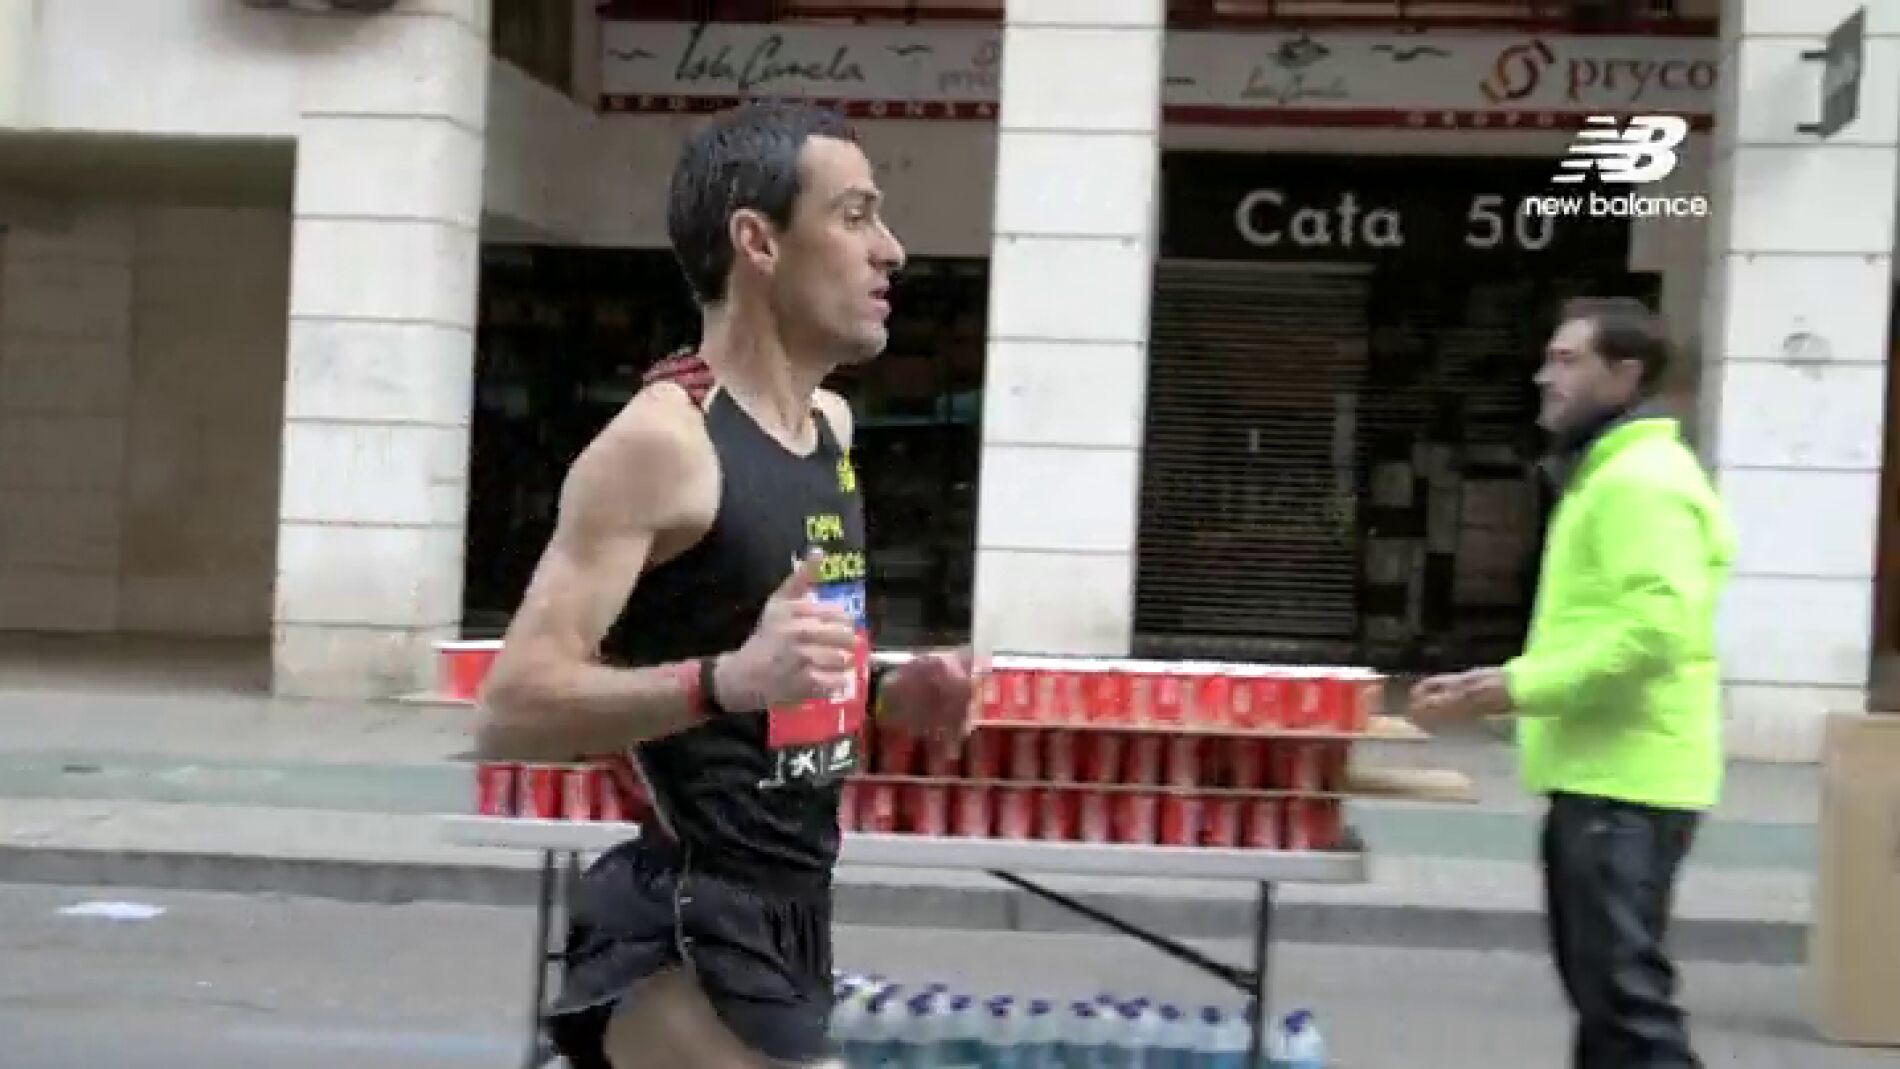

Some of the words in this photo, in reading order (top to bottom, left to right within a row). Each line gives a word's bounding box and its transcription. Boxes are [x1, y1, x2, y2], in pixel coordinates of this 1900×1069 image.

[1567, 56, 1719, 102] pryco
[1235, 188, 1405, 247] Cata
[1464, 195, 1556, 250] 50
